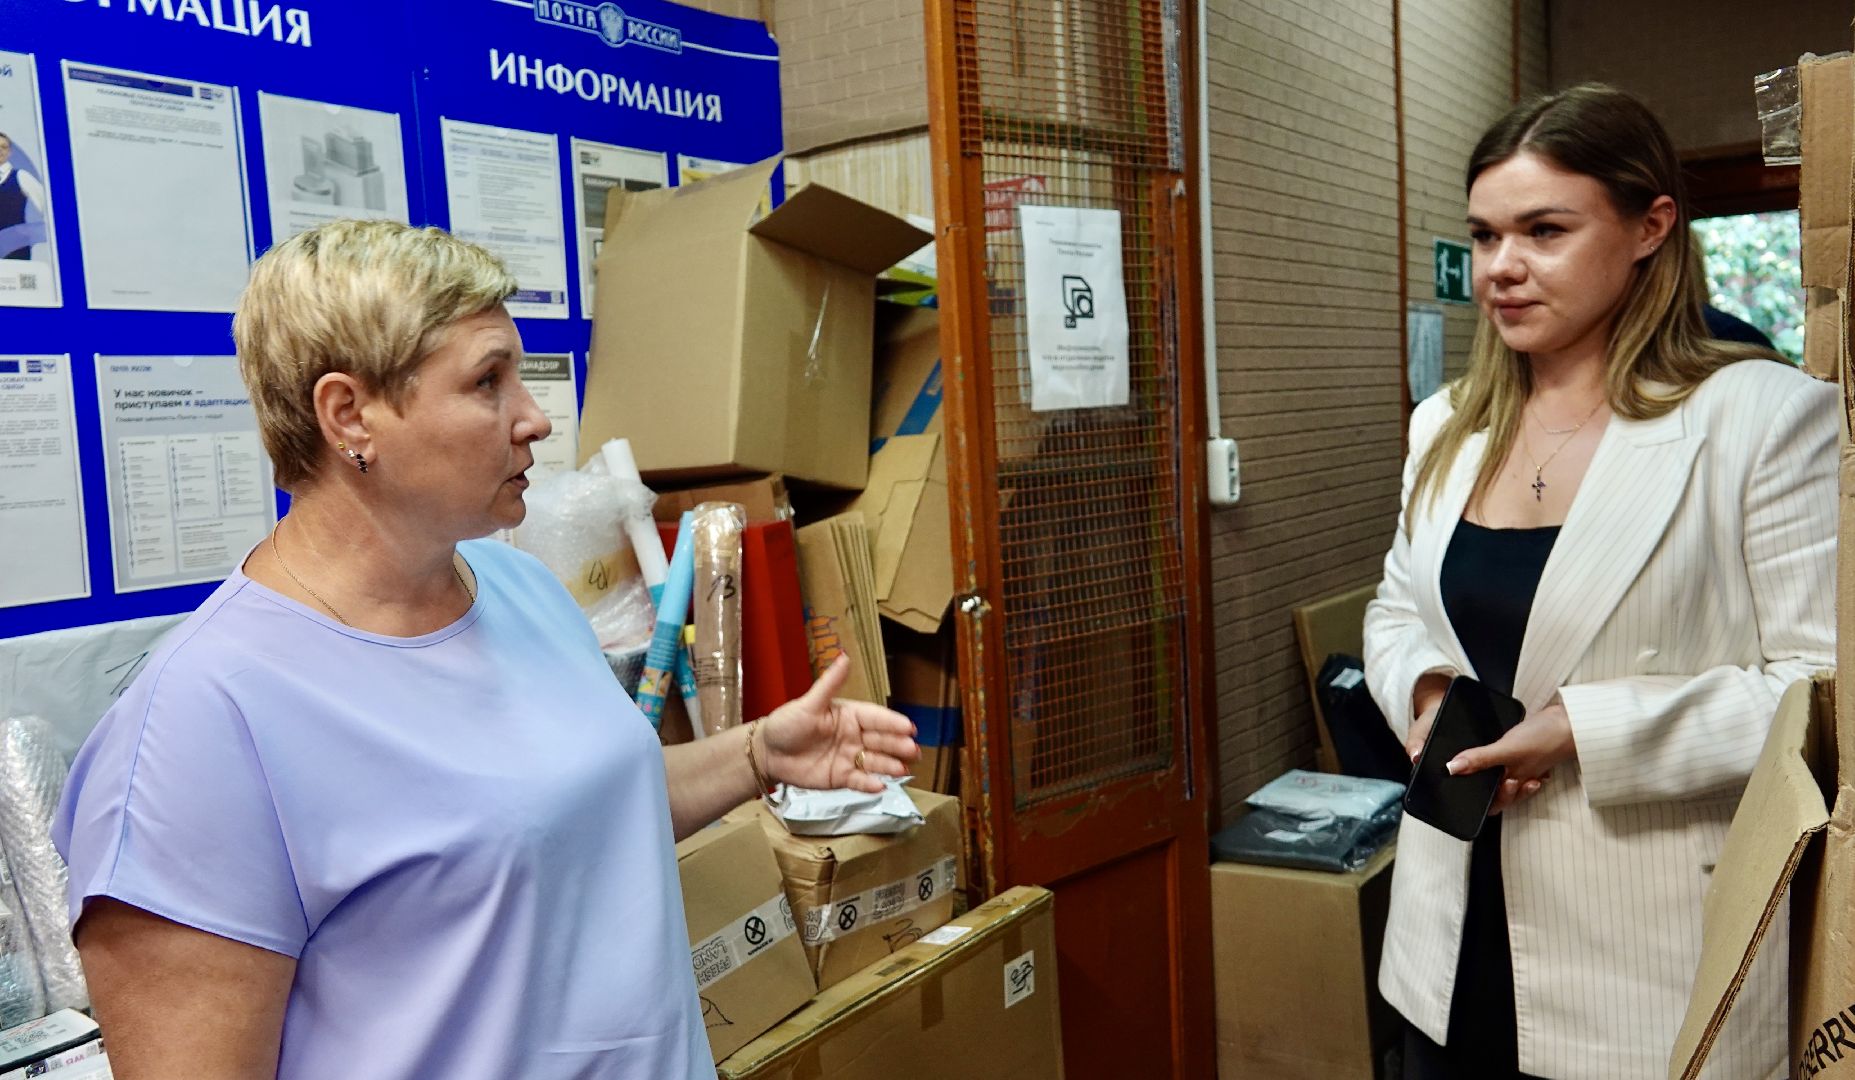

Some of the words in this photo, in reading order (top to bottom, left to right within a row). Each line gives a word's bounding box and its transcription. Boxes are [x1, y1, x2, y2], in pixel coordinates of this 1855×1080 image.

[538, 0, 598, 29] ПОЧТА
[627, 21, 679, 49] РОССИИ
[489, 48, 722, 122] ИНФОРМАЦИЯ
[114, 400, 182, 411] приступаем
[125, 390, 145, 398] нас
[147, 389, 193, 397] новичок
